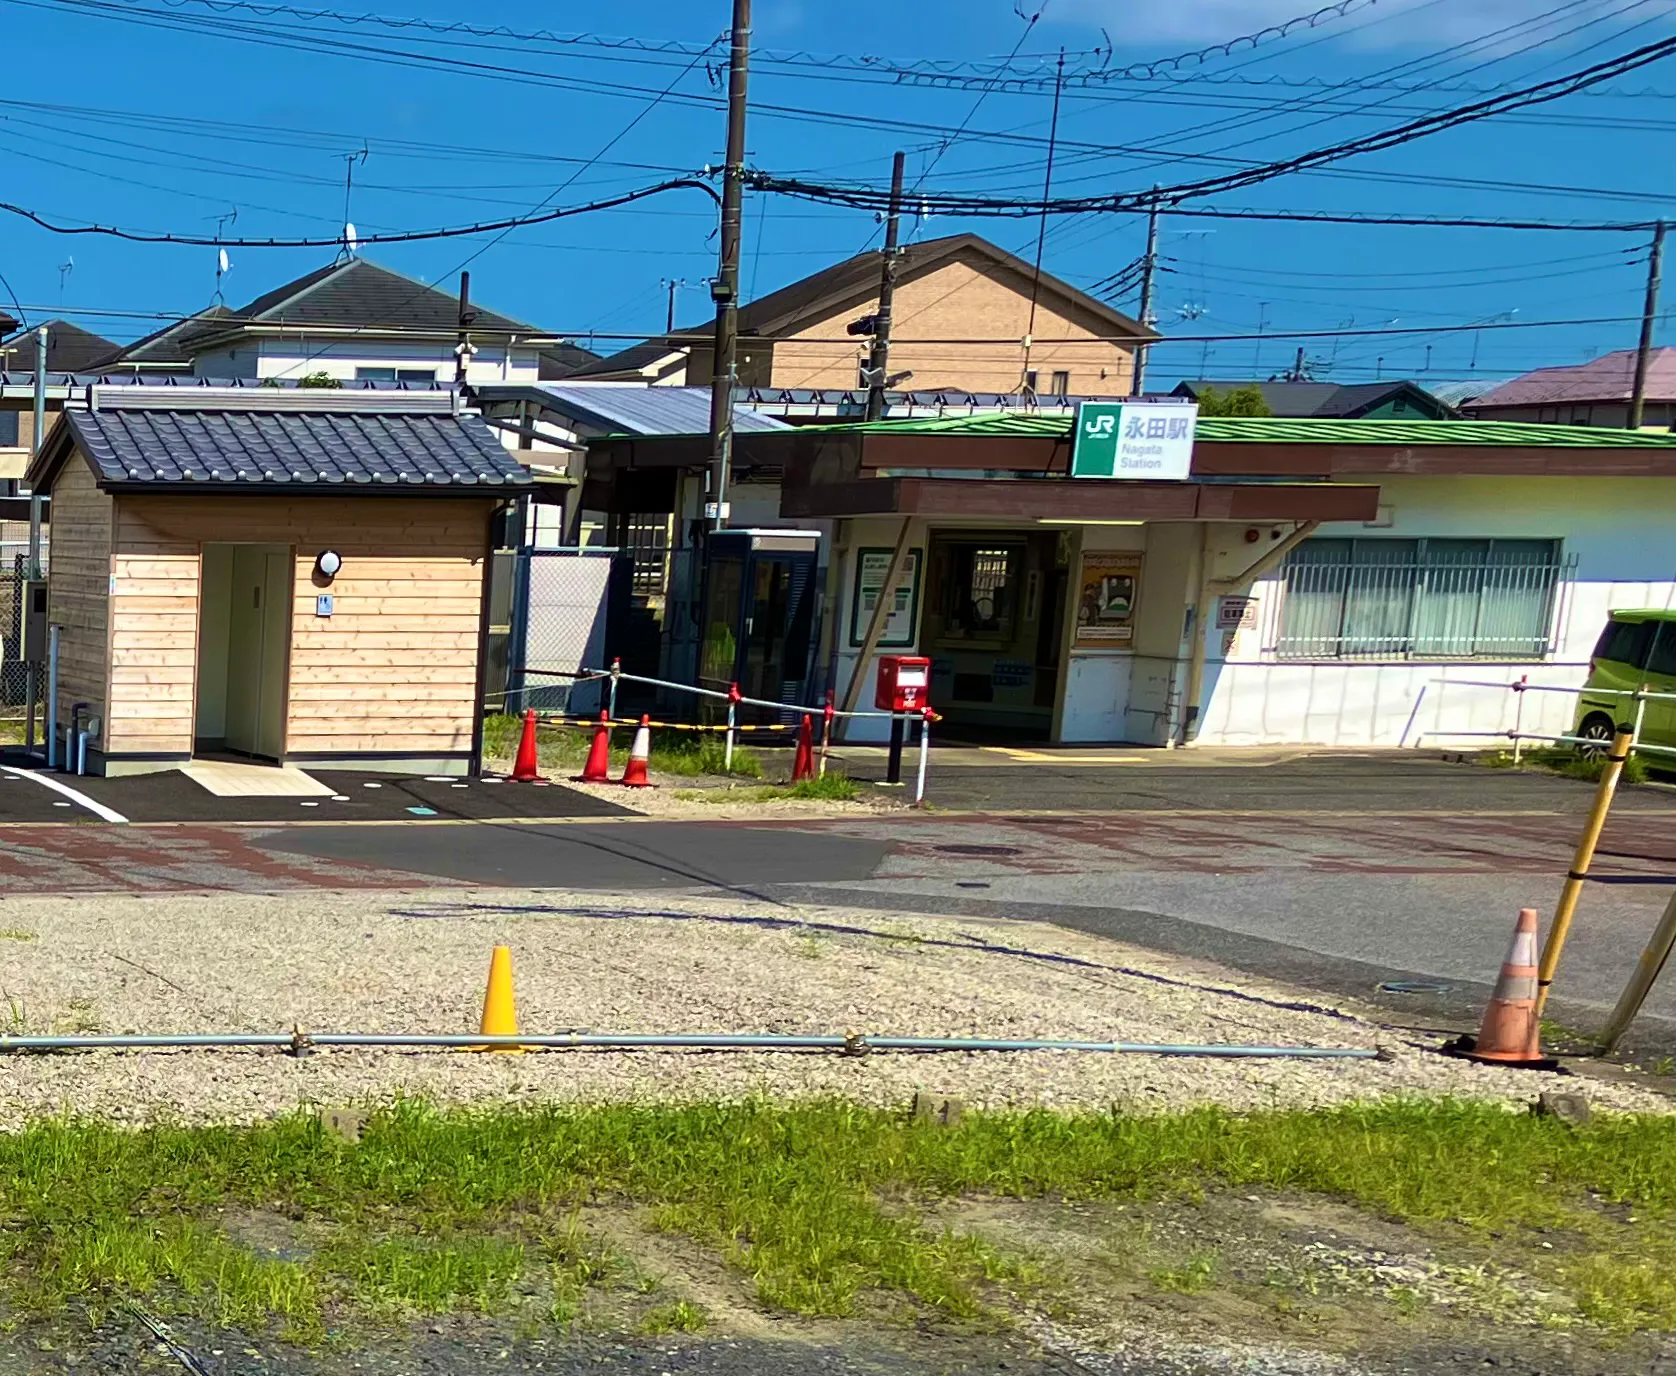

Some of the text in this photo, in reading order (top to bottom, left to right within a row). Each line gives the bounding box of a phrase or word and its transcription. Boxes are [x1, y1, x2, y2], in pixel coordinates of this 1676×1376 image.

[1085, 415, 1115, 433] JR
[1125, 416, 1189, 439] 永田駅
[1122, 443, 1162, 457] Nagata
[1120, 457, 1161, 468] Station
